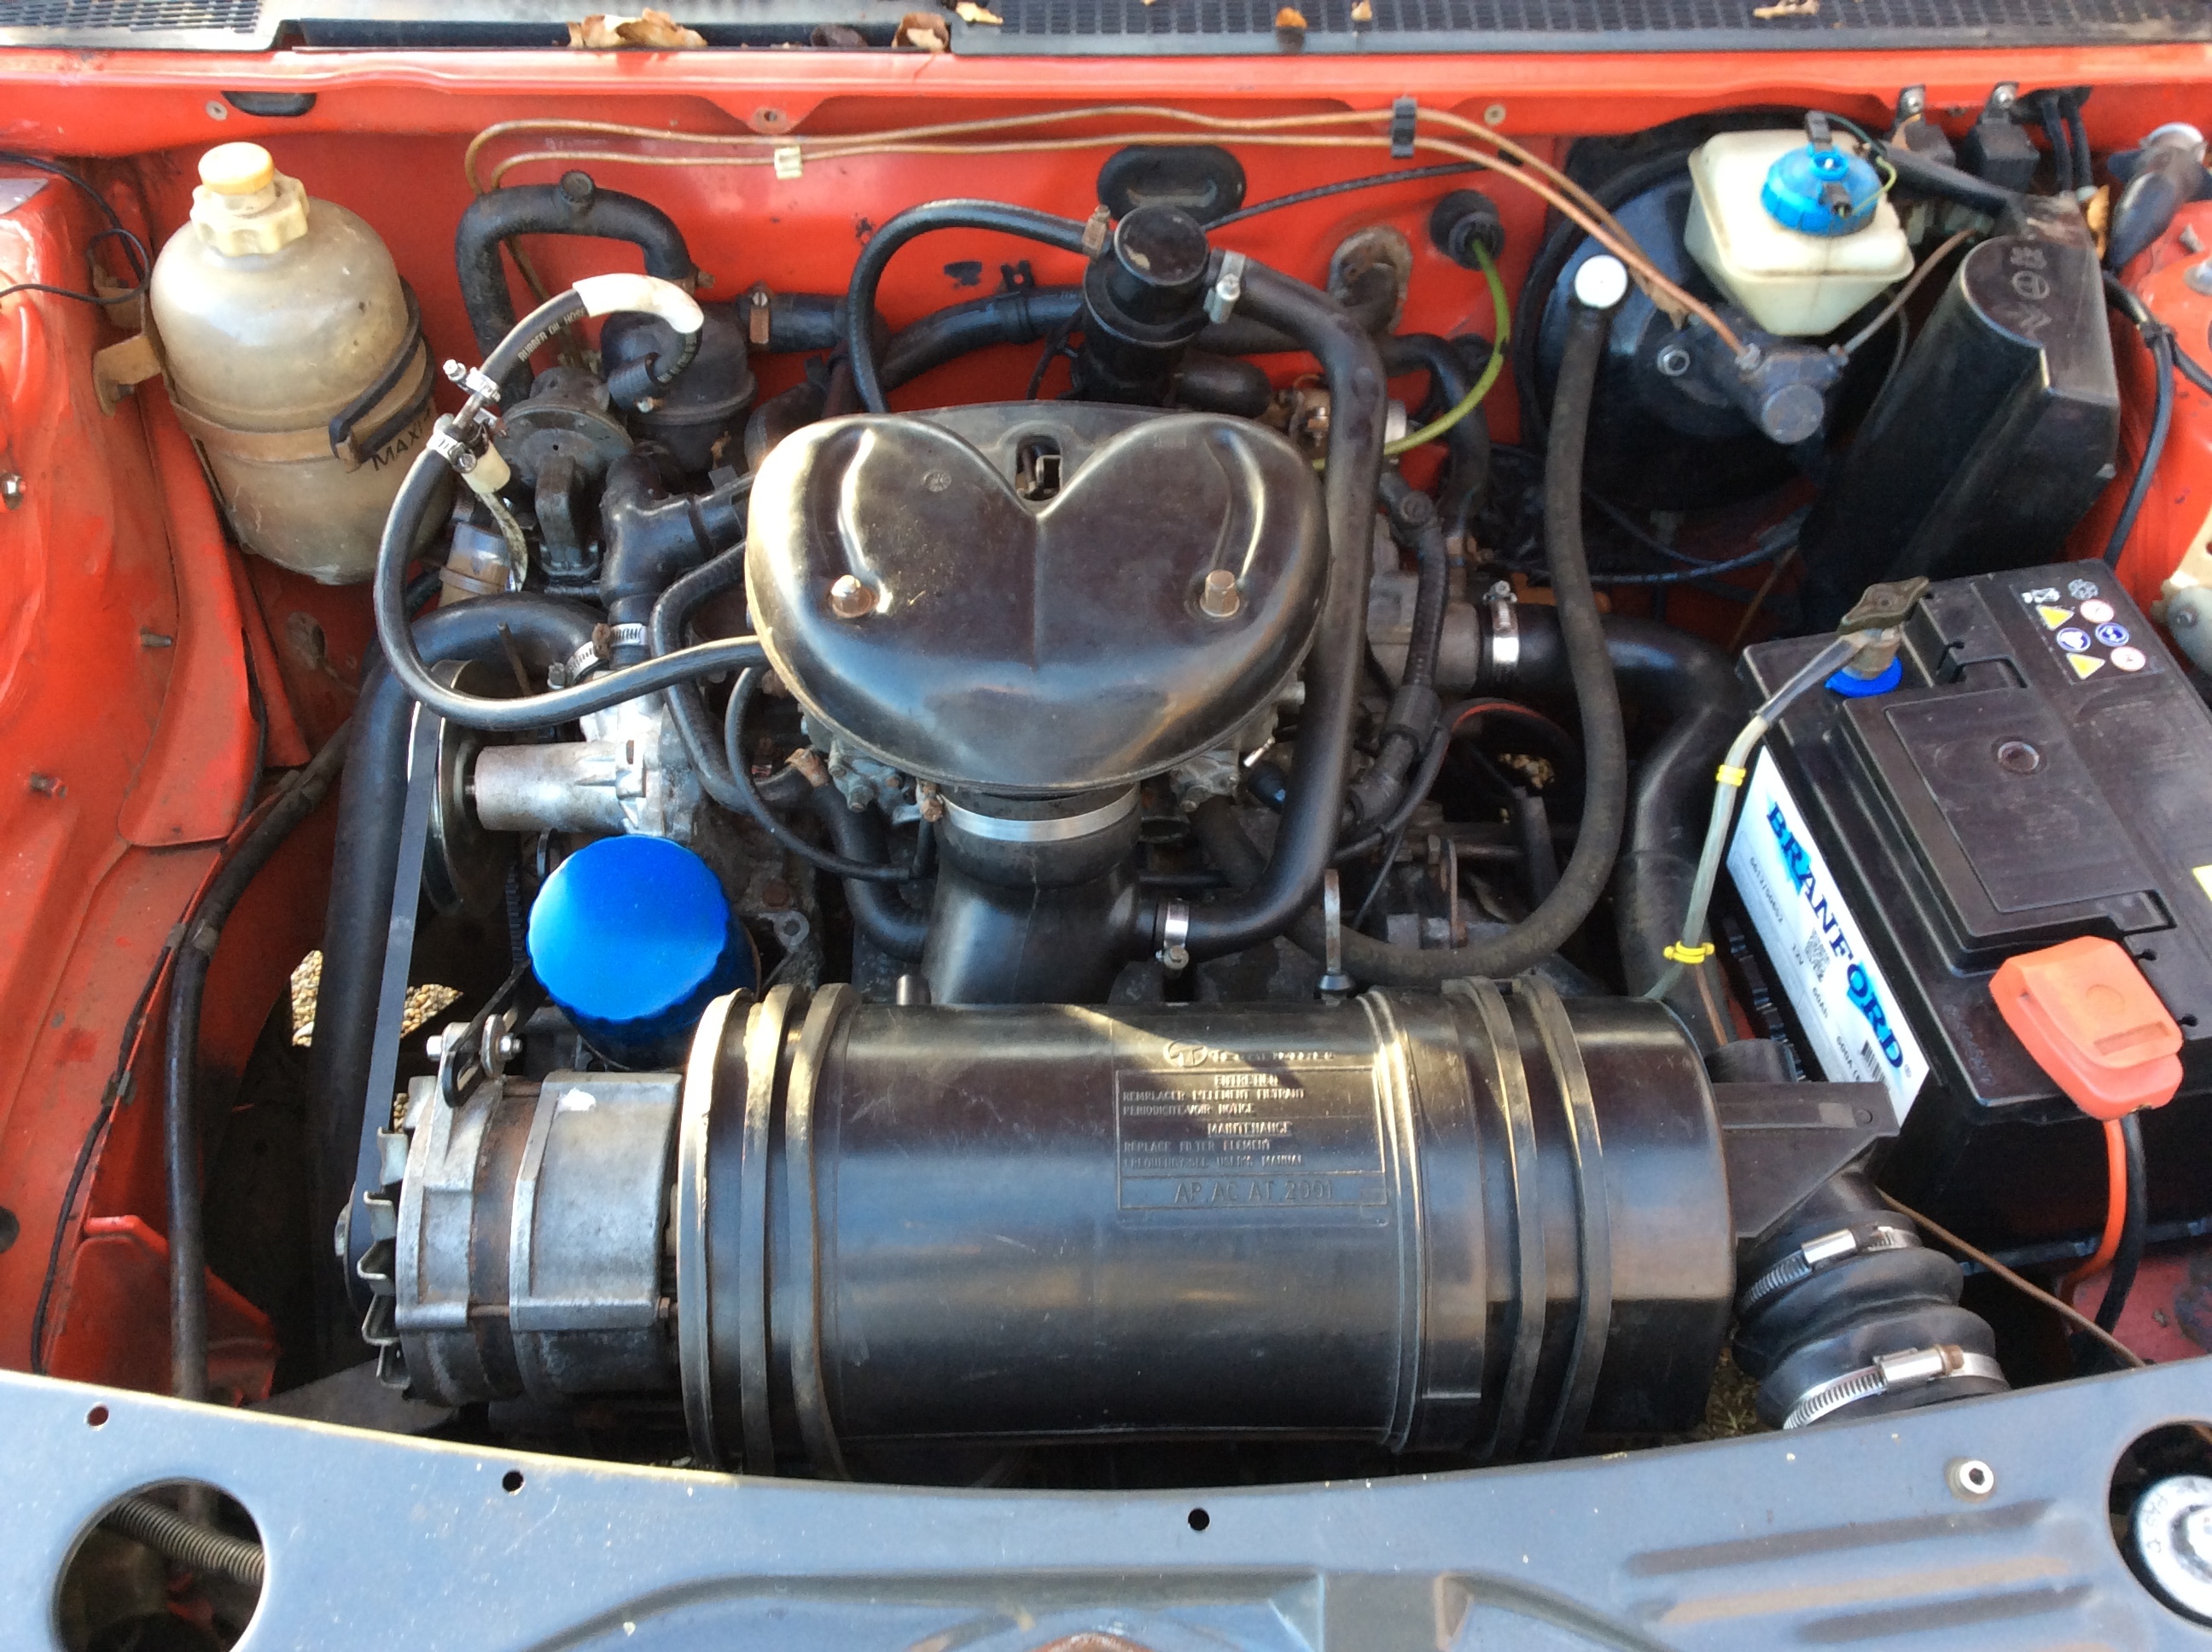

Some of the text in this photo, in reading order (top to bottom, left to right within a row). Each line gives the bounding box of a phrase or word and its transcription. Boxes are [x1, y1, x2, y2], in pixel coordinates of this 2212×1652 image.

[517, 331, 549, 362] RUBBER
[1766, 801, 1903, 1067] BRANFORD
[1208, 1121, 1292, 1135] MAINTENANCE
[1124, 1138, 1270, 1152] REPLACE FILTER ELEMENT
